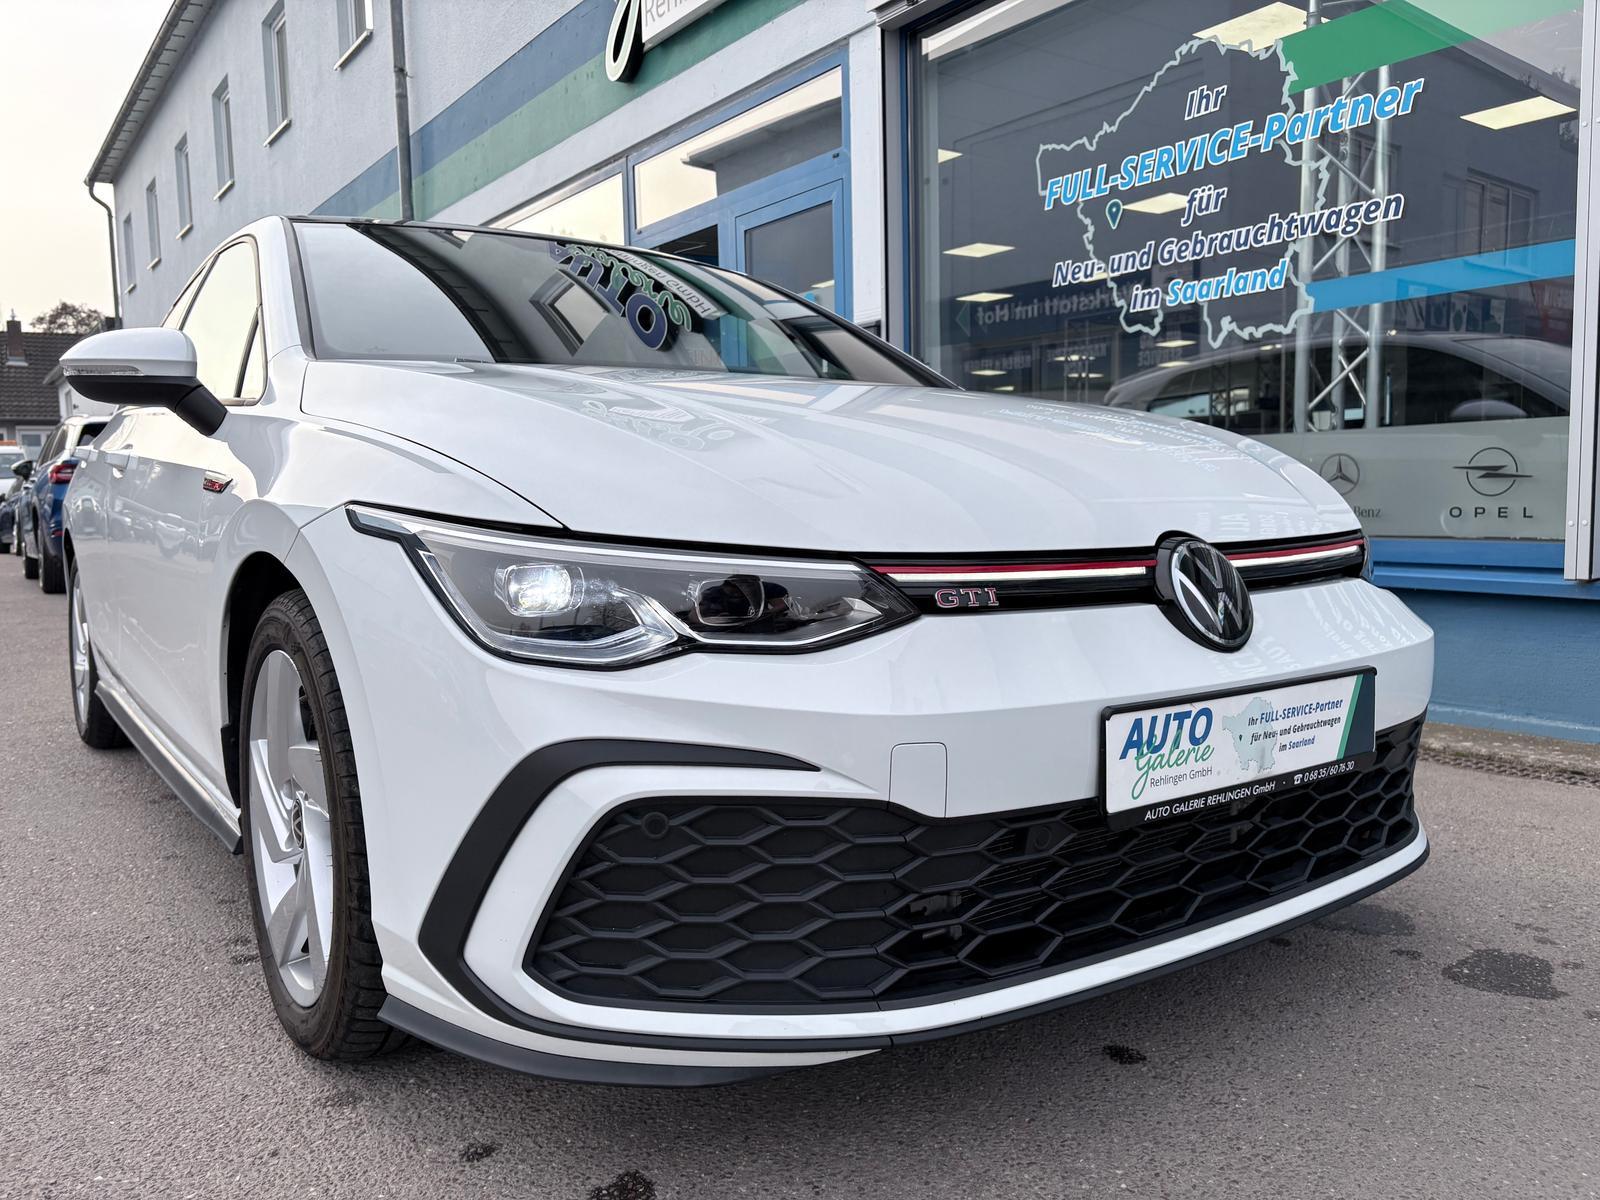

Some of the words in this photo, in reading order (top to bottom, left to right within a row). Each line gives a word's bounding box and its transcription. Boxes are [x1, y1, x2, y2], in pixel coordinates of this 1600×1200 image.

[1184, 85, 1228, 121] Ihr
[1044, 77, 1425, 211] FULL-SERVICE-Partner
[1181, 184, 1228, 227] für
[1052, 259, 1106, 288] Neu-
[1108, 241, 1155, 277] und
[1157, 193, 1405, 267] Gebrauchtwagen
[1129, 284, 1162, 313] im
[1165, 257, 1290, 308] Saarland
[1449, 506, 1534, 519] OPEL
[934, 587, 1000, 609] GTI
[1248, 716, 1259, 727] Ihr
[1259, 699, 1344, 725] FULL-SERVICE-Partner
[1250, 732, 1262, 745] für
[1279, 724, 1292, 737] und
[1292, 716, 1342, 734] Gebrauchtwagen
[1119, 707, 1213, 760] AUTO
[1278, 742, 1288, 752] im
[1288, 735, 1316, 750] Saarland
[1131, 733, 1215, 800] Galerie
[1150, 772, 1188, 788] Rehlingen
[1189, 765, 1213, 780] GmbH
[1144, 805, 1170, 821] AUTO
[1172, 797, 1206, 814] GALERIE
[1206, 786, 1252, 807] REHLINGEN
[1252, 780, 1276, 795] GmbH
